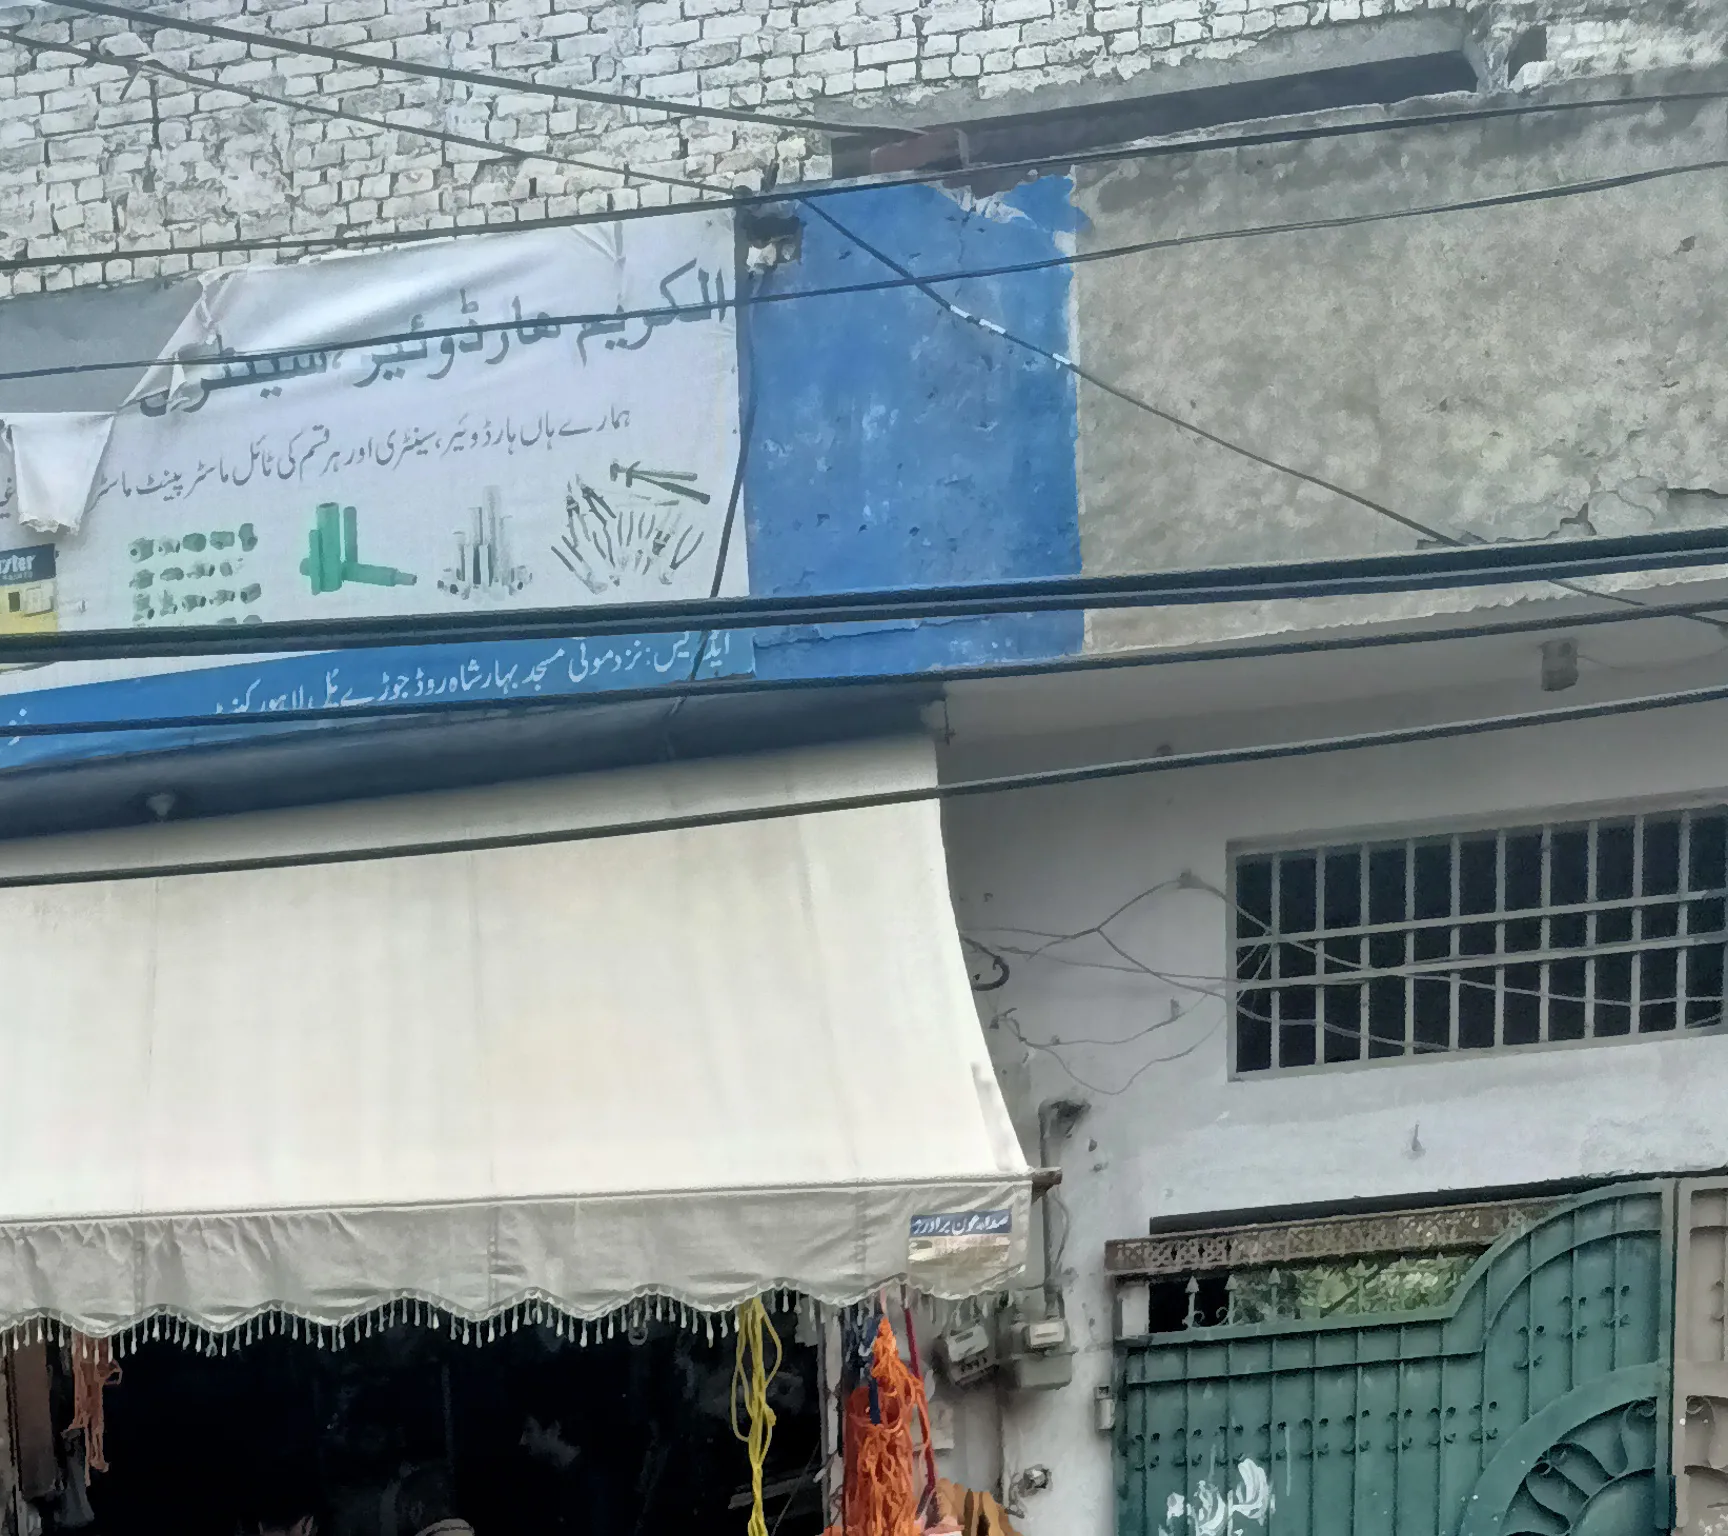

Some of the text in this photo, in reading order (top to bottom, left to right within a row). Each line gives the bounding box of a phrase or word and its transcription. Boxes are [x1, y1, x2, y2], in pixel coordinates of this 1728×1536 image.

[577, 257, 726, 367] الکریم
[521, 411, 556, 451] ہاں
[558, 404, 630, 437] ہمارے
[232, 435, 273, 486] ٹائل
[276, 429, 306, 480] کی
[299, 425, 330, 482] قسم
[319, 450, 341, 477] ہر
[343, 437, 373, 466] اور
[135, 469, 183, 502] پینٹ
[183, 456, 229, 500] ماسٹر
[413, 666, 447, 697] روڈ
[522, 647, 566, 692] مسجد
